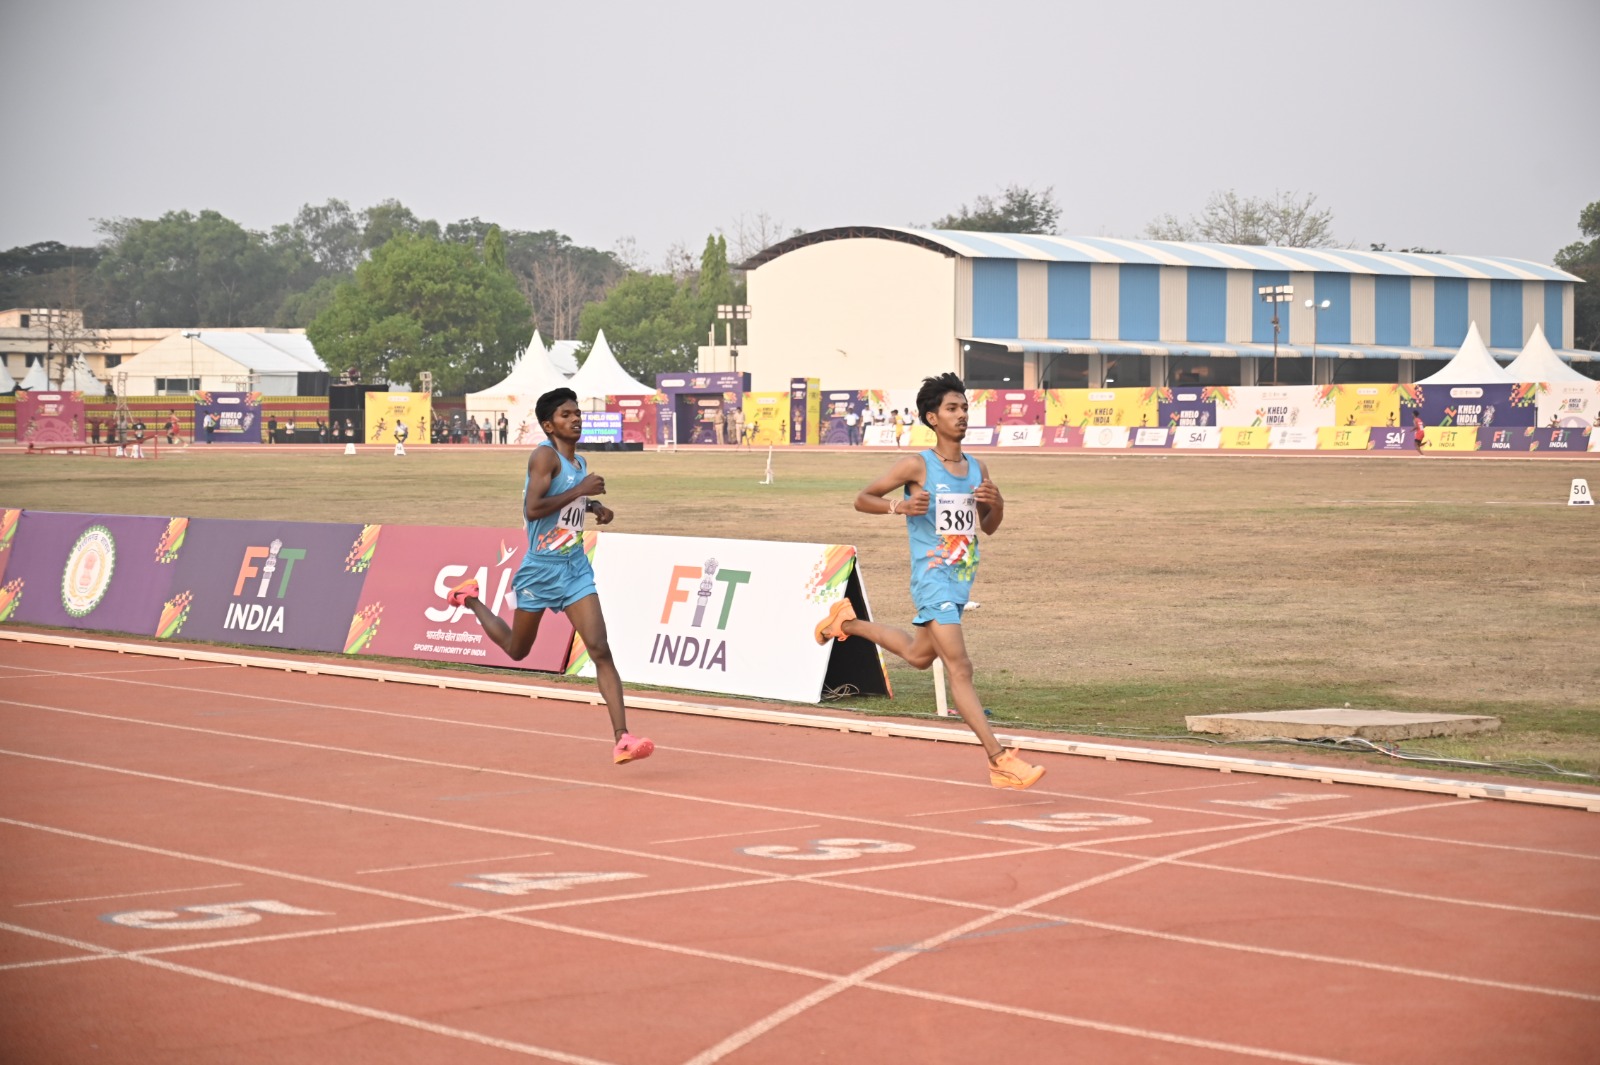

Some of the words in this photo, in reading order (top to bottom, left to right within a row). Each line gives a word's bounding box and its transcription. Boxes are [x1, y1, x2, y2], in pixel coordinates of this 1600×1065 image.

[220, 411, 242, 419] KHELO
[1180, 410, 1199, 418] KHELO
[1458, 405, 1482, 414] KHELO
[1180, 418, 1196, 426] INDIA
[1266, 415, 1284, 423] INDIA
[1457, 414, 1478, 423] INDIA
[1189, 431, 1207, 442] SAI
[1385, 431, 1405, 444] SAI
[1573, 485, 1587, 495] 50
[939, 509, 974, 531] 389
[223, 602, 285, 633] INDIA
[426, 628, 445, 641] भारतीय
[445, 629, 456, 641] खेल
[413, 643, 433, 652] SPORTS
[433, 645, 463, 654] AUTHORITY
[649, 633, 727, 672] INDIA
[740, 838, 916, 860] 3
[109, 900, 337, 930] 5
